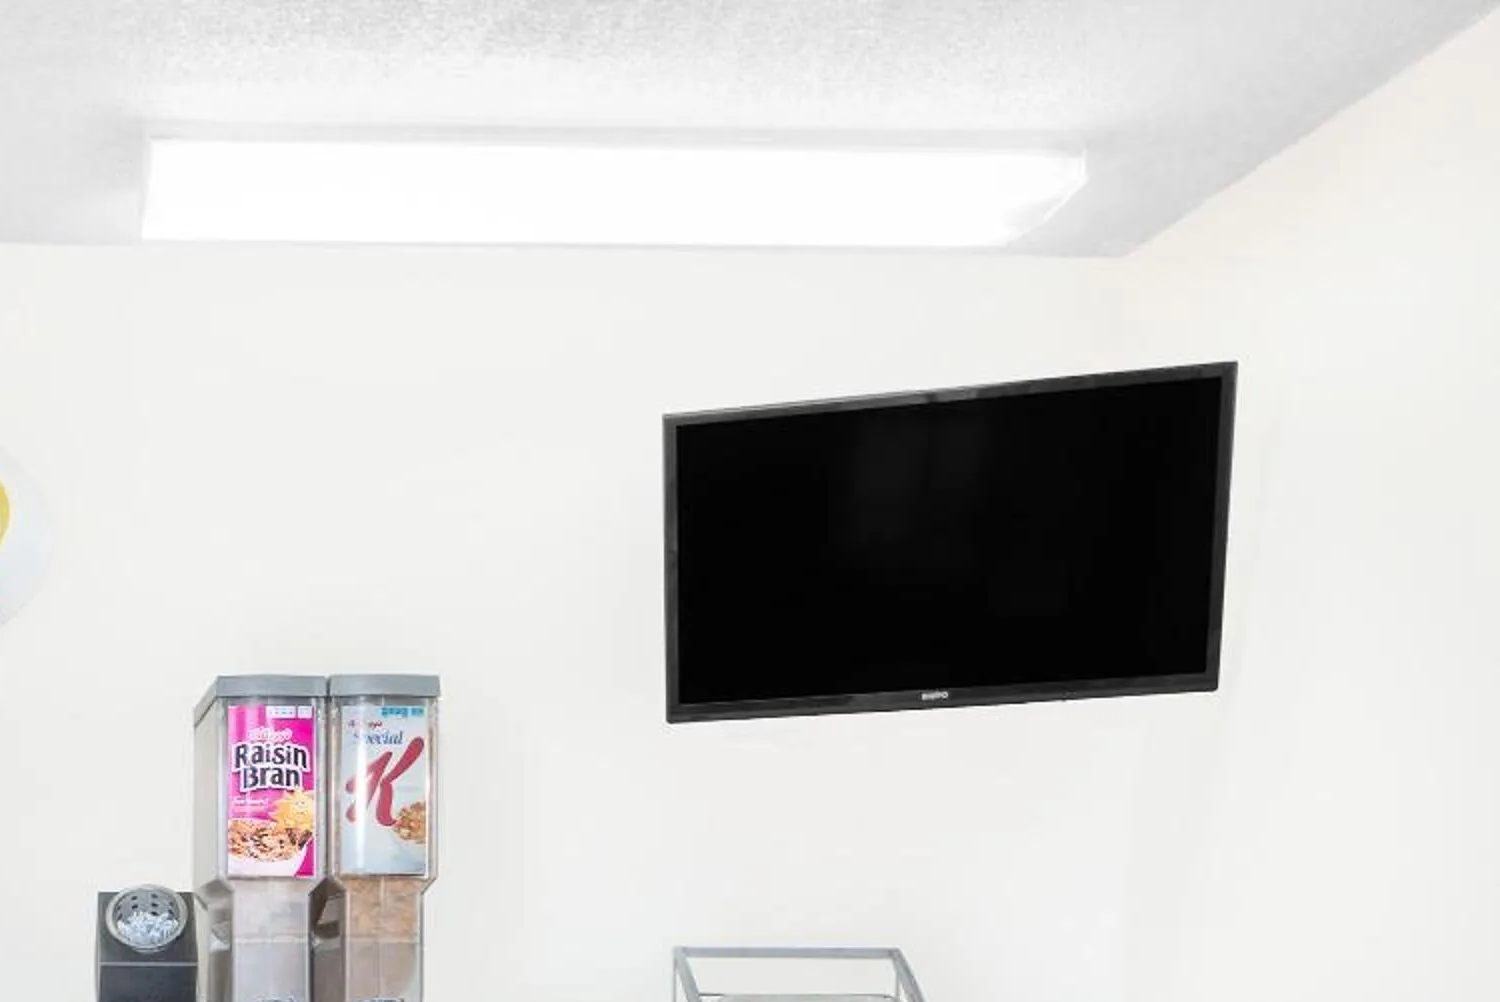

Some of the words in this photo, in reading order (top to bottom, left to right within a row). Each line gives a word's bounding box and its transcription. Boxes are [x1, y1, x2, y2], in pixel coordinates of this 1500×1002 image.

[234, 743, 308, 769] Raisin
[243, 766, 301, 789] Bran
[346, 737, 425, 827] K
